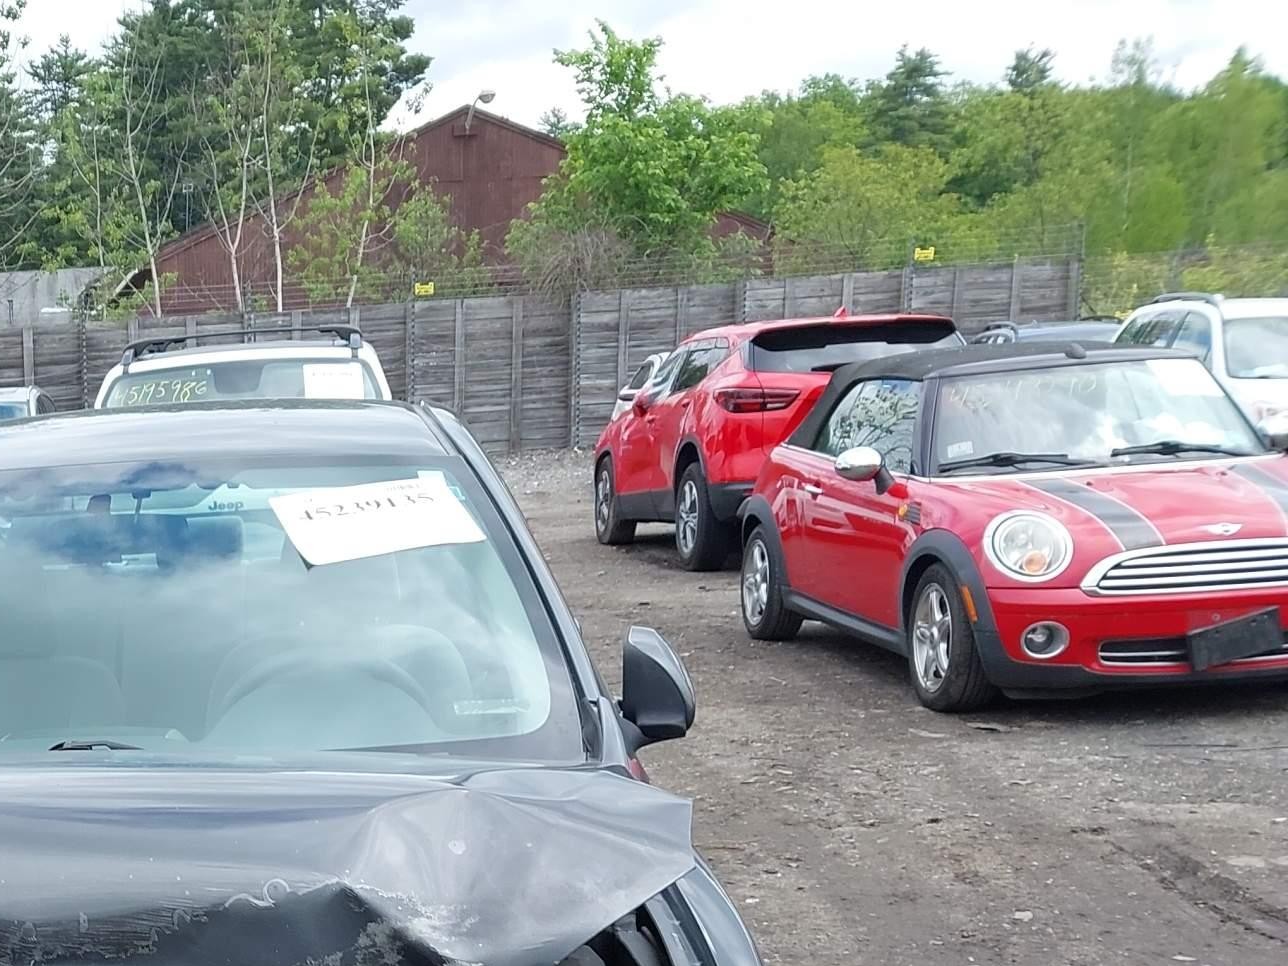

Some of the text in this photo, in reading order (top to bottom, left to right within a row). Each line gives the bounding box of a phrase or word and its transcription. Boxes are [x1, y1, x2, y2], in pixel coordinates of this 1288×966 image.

[113, 379, 208, 406] 45195986
[208, 500, 244, 512] Jeep
[298, 492, 435, 521] 45239135
